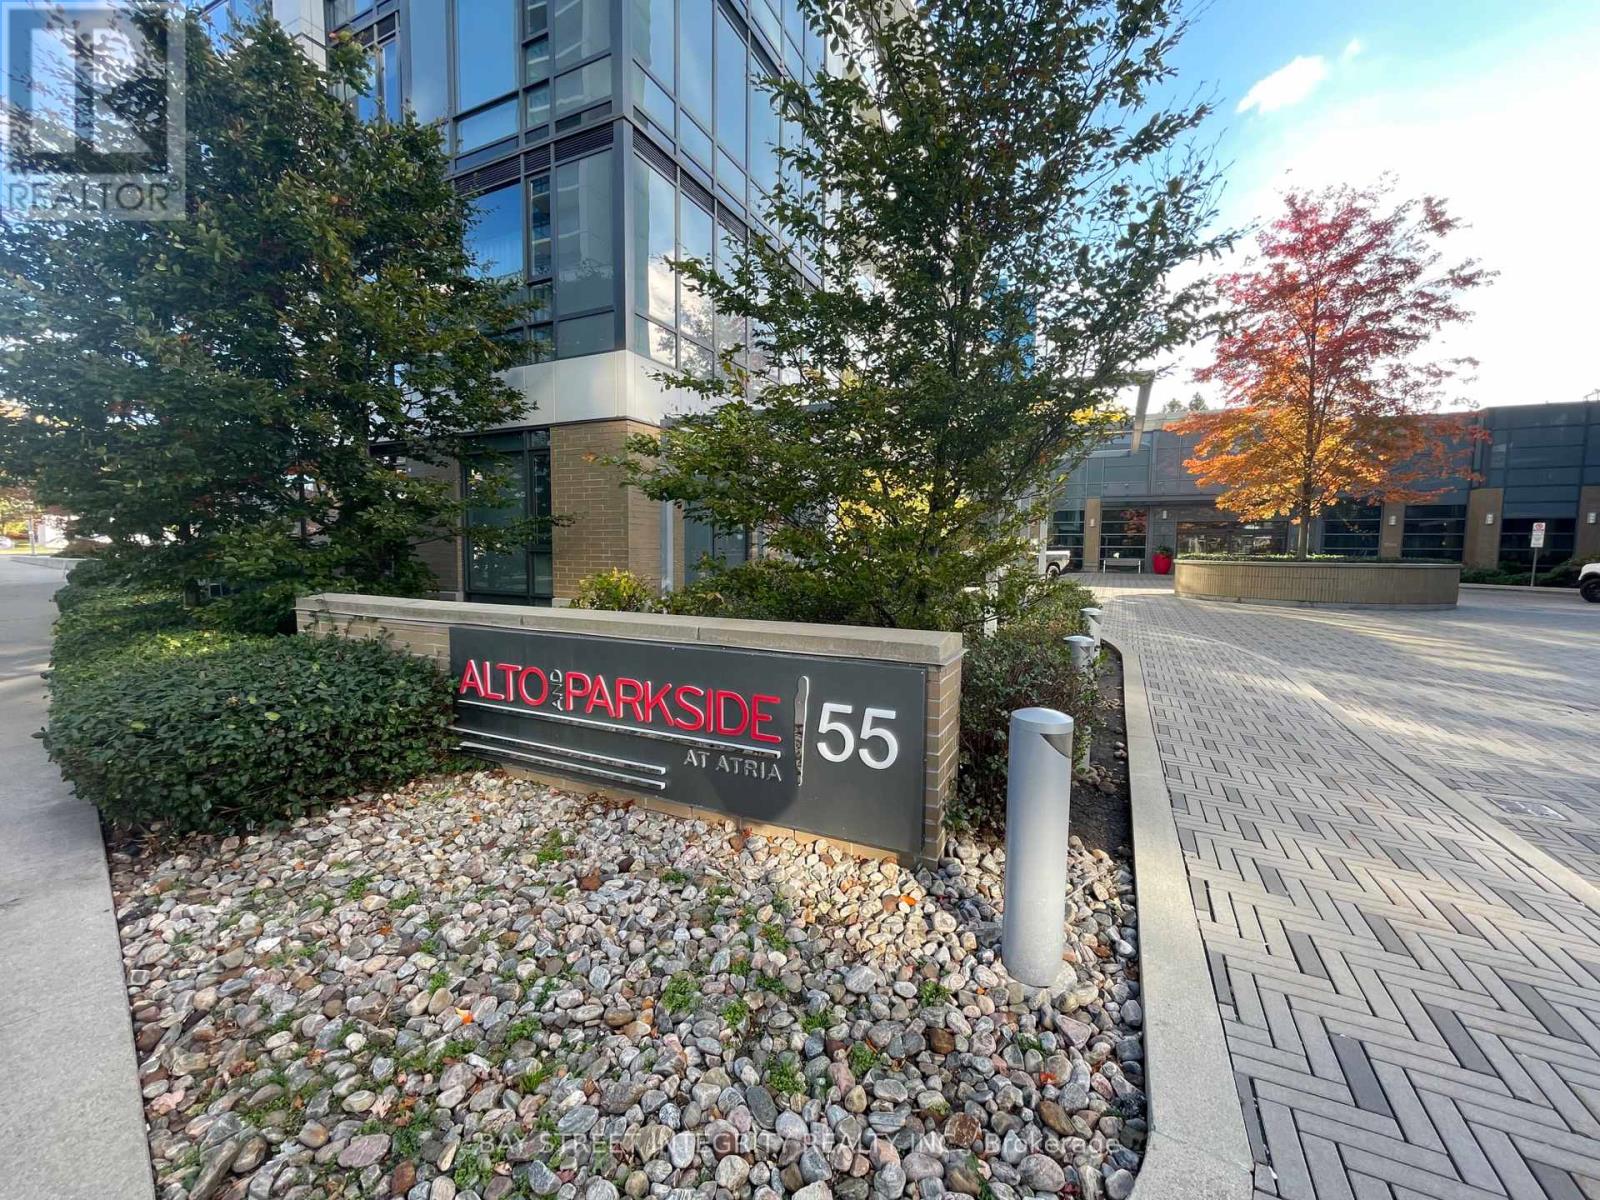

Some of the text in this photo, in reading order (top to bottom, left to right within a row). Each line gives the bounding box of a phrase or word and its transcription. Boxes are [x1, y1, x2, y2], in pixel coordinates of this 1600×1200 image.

[460, 659, 782, 743] ALTO AND PARKSIDE
[684, 749, 782, 783] AT ATRIA
[816, 702, 899, 770] 55
